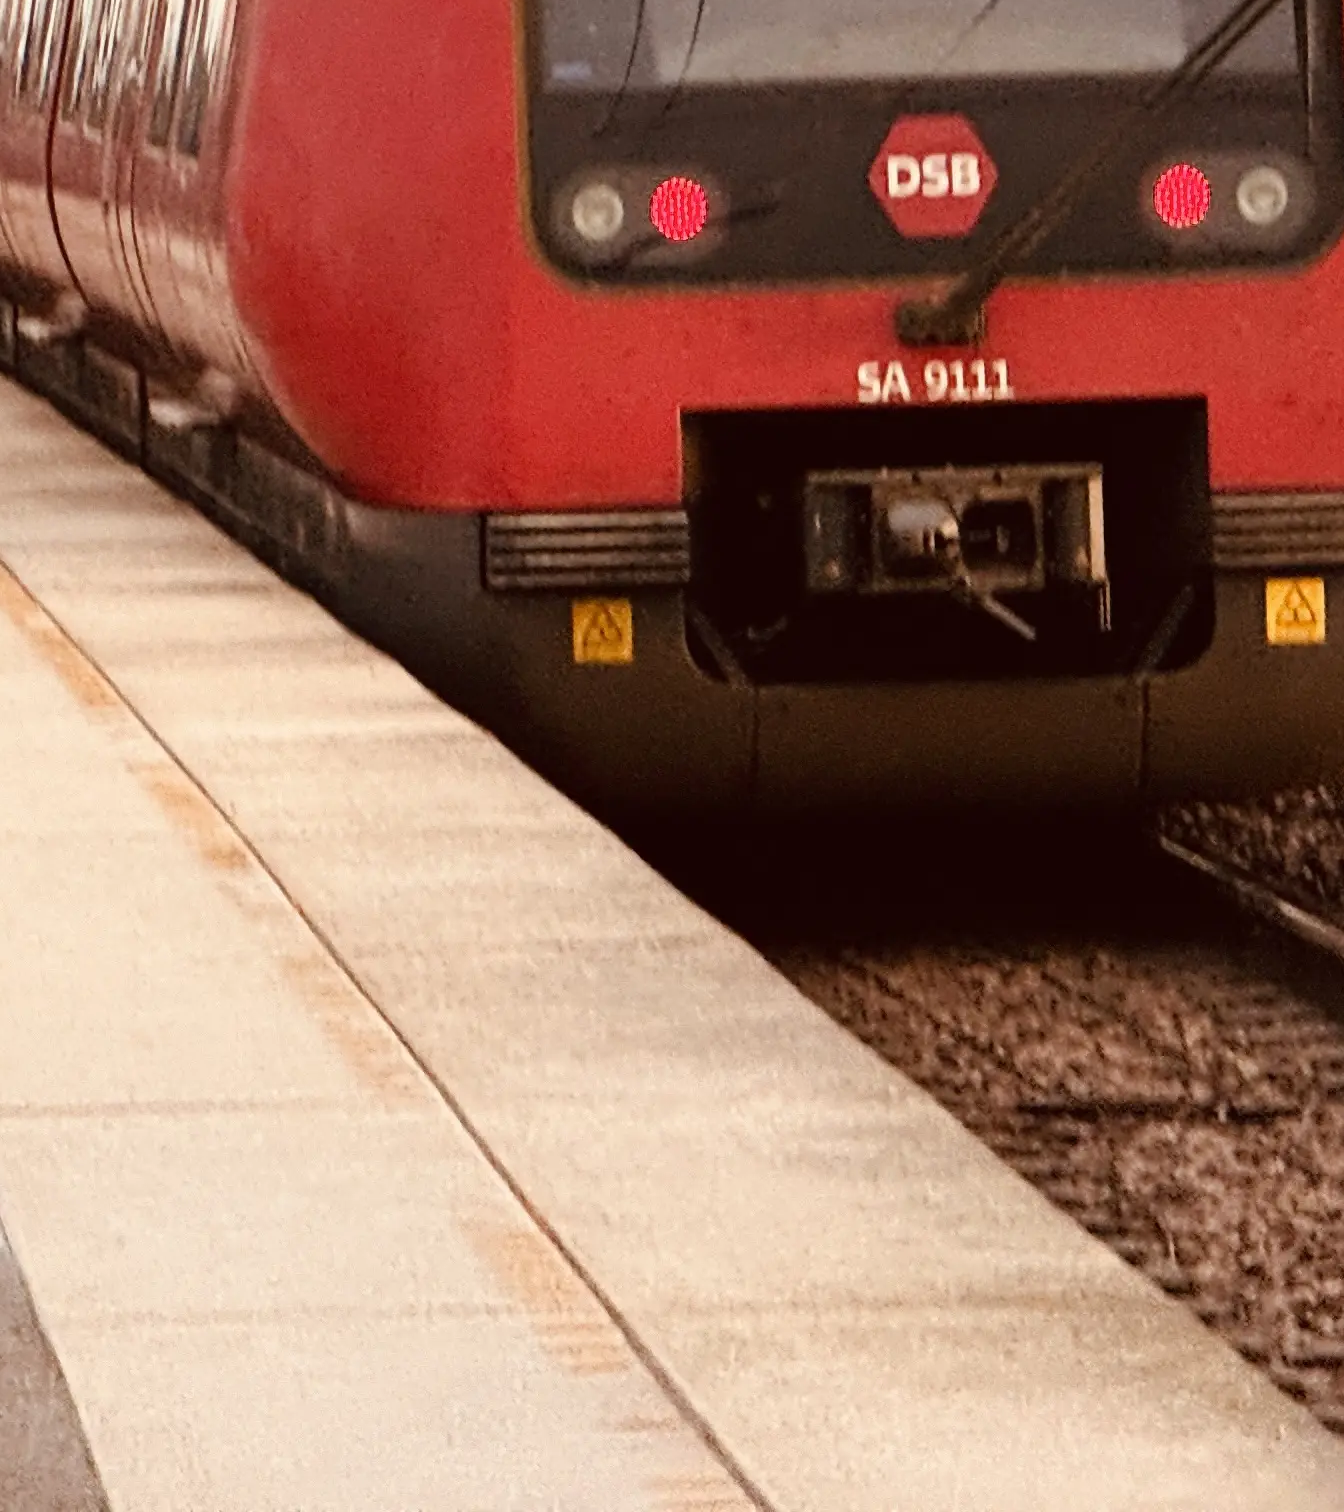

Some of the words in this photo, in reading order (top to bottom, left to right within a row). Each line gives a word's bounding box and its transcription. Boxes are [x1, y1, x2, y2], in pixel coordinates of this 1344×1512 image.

[886, 152, 981, 198] DSB
[857, 359, 912, 404] SA
[923, 357, 1016, 403] 9111
